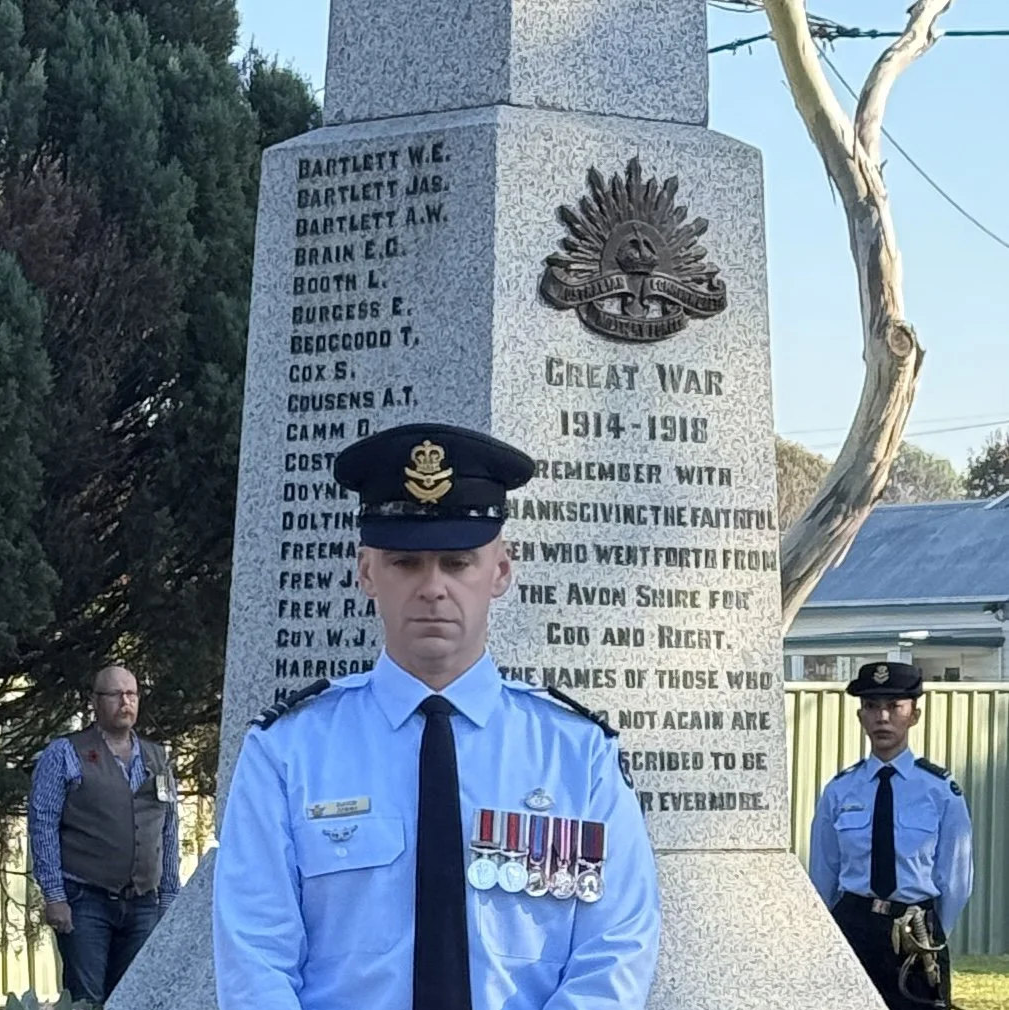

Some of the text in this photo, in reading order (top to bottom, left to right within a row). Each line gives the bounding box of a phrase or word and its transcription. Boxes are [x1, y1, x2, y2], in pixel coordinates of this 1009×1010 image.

[297, 152, 399, 179] BARTLETT
[297, 180, 399, 209] BARTLETT
[295, 210, 397, 237] BARTLETT
[294, 243, 355, 266] BRAIN
[293, 270, 388, 295] BOOTH L.
[292, 301, 382, 324] BURGESS
[400, 326, 420, 347] T.
[289, 361, 356, 383] COX S.
[545, 356, 724, 396] GREAT WAR
[287, 391, 375, 412] COUSENS
[286, 422, 344, 441] CAMM
[285, 452, 340, 472] COST
[675, 464, 732, 487] WITH
[282, 511, 362, 531] DOLTIN
[505, 498, 777, 531] HANKSGIVING THE FAITHFUL
[281, 541, 356, 560] FREEMA
[506, 540, 777, 571] EN WHO WENT FORTH FROM
[279, 571, 333, 590] FREW
[518, 584, 557, 605] THE
[708, 589, 752, 610] FOR
[278, 599, 331, 619] FREW
[602, 626, 645, 647] AND
[498, 665, 774, 691] THE NAMES OF THOSE WHO
[619, 710, 658, 730] NOT
[662, 710, 724, 730] AGAIN
[731, 710, 772, 731] ARE
[710, 751, 736, 771] TO
[742, 751, 768, 771] BE
